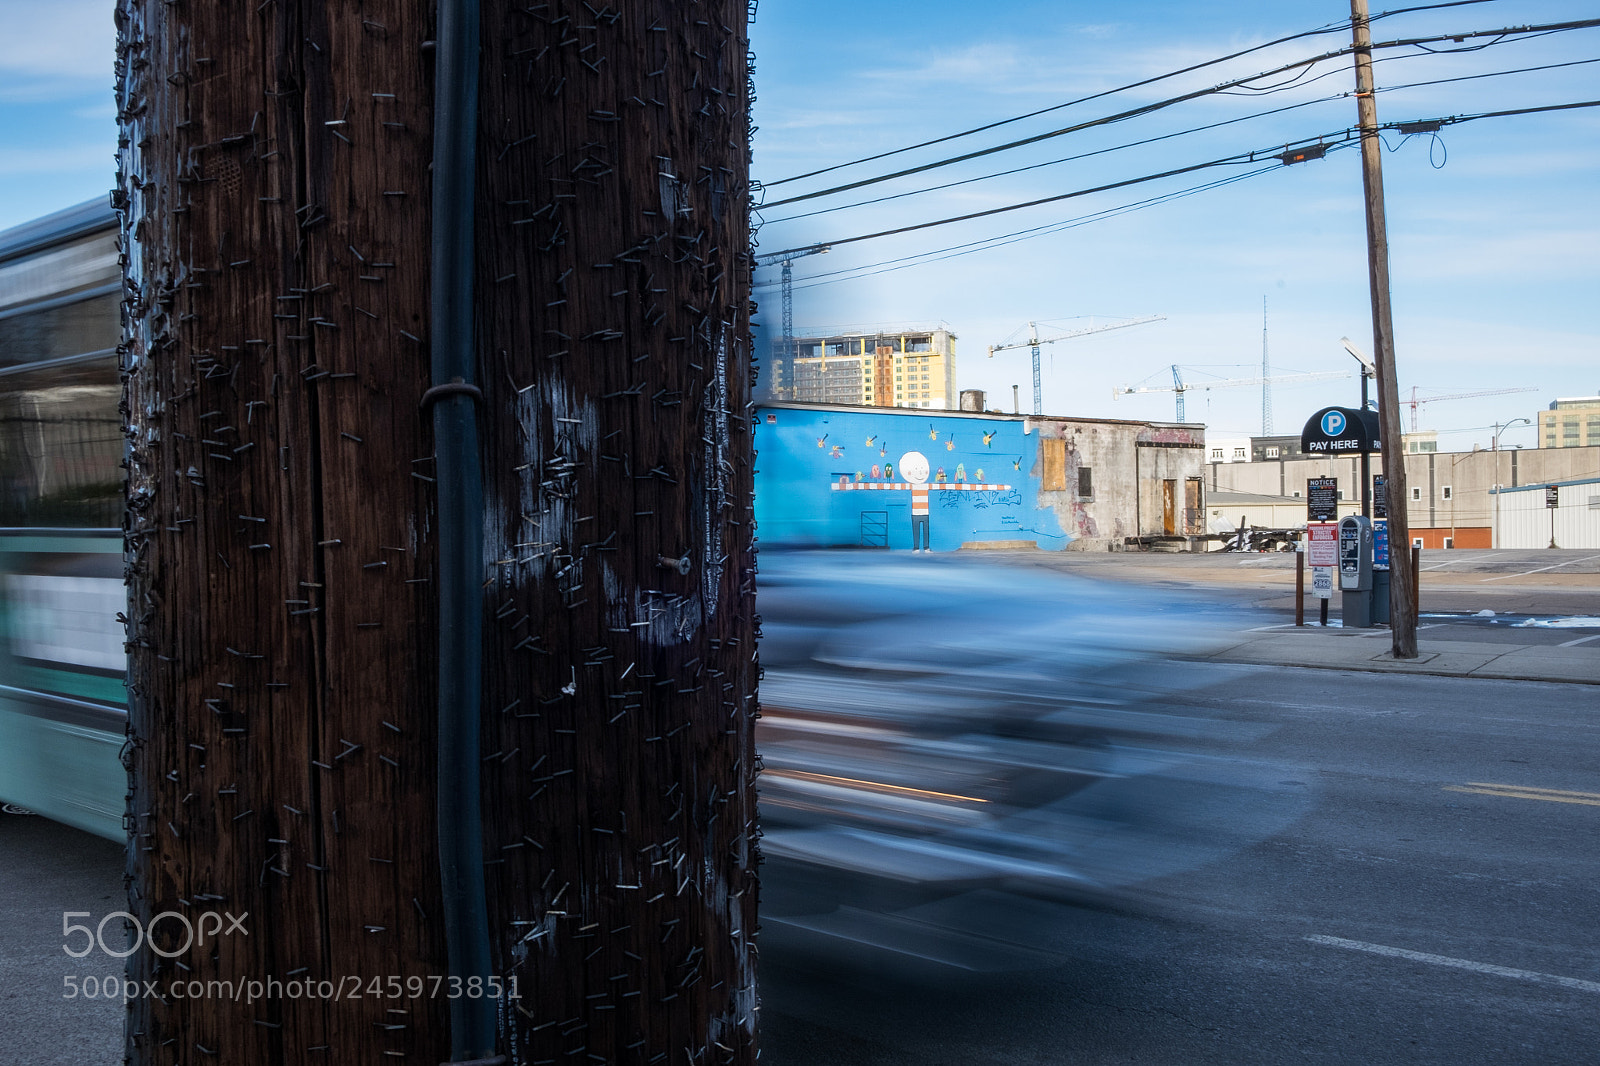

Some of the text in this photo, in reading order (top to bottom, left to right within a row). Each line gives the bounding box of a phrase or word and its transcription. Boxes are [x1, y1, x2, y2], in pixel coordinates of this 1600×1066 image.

[1328, 415, 1342, 433] P
[1309, 439, 1359, 451] PAY HERE
